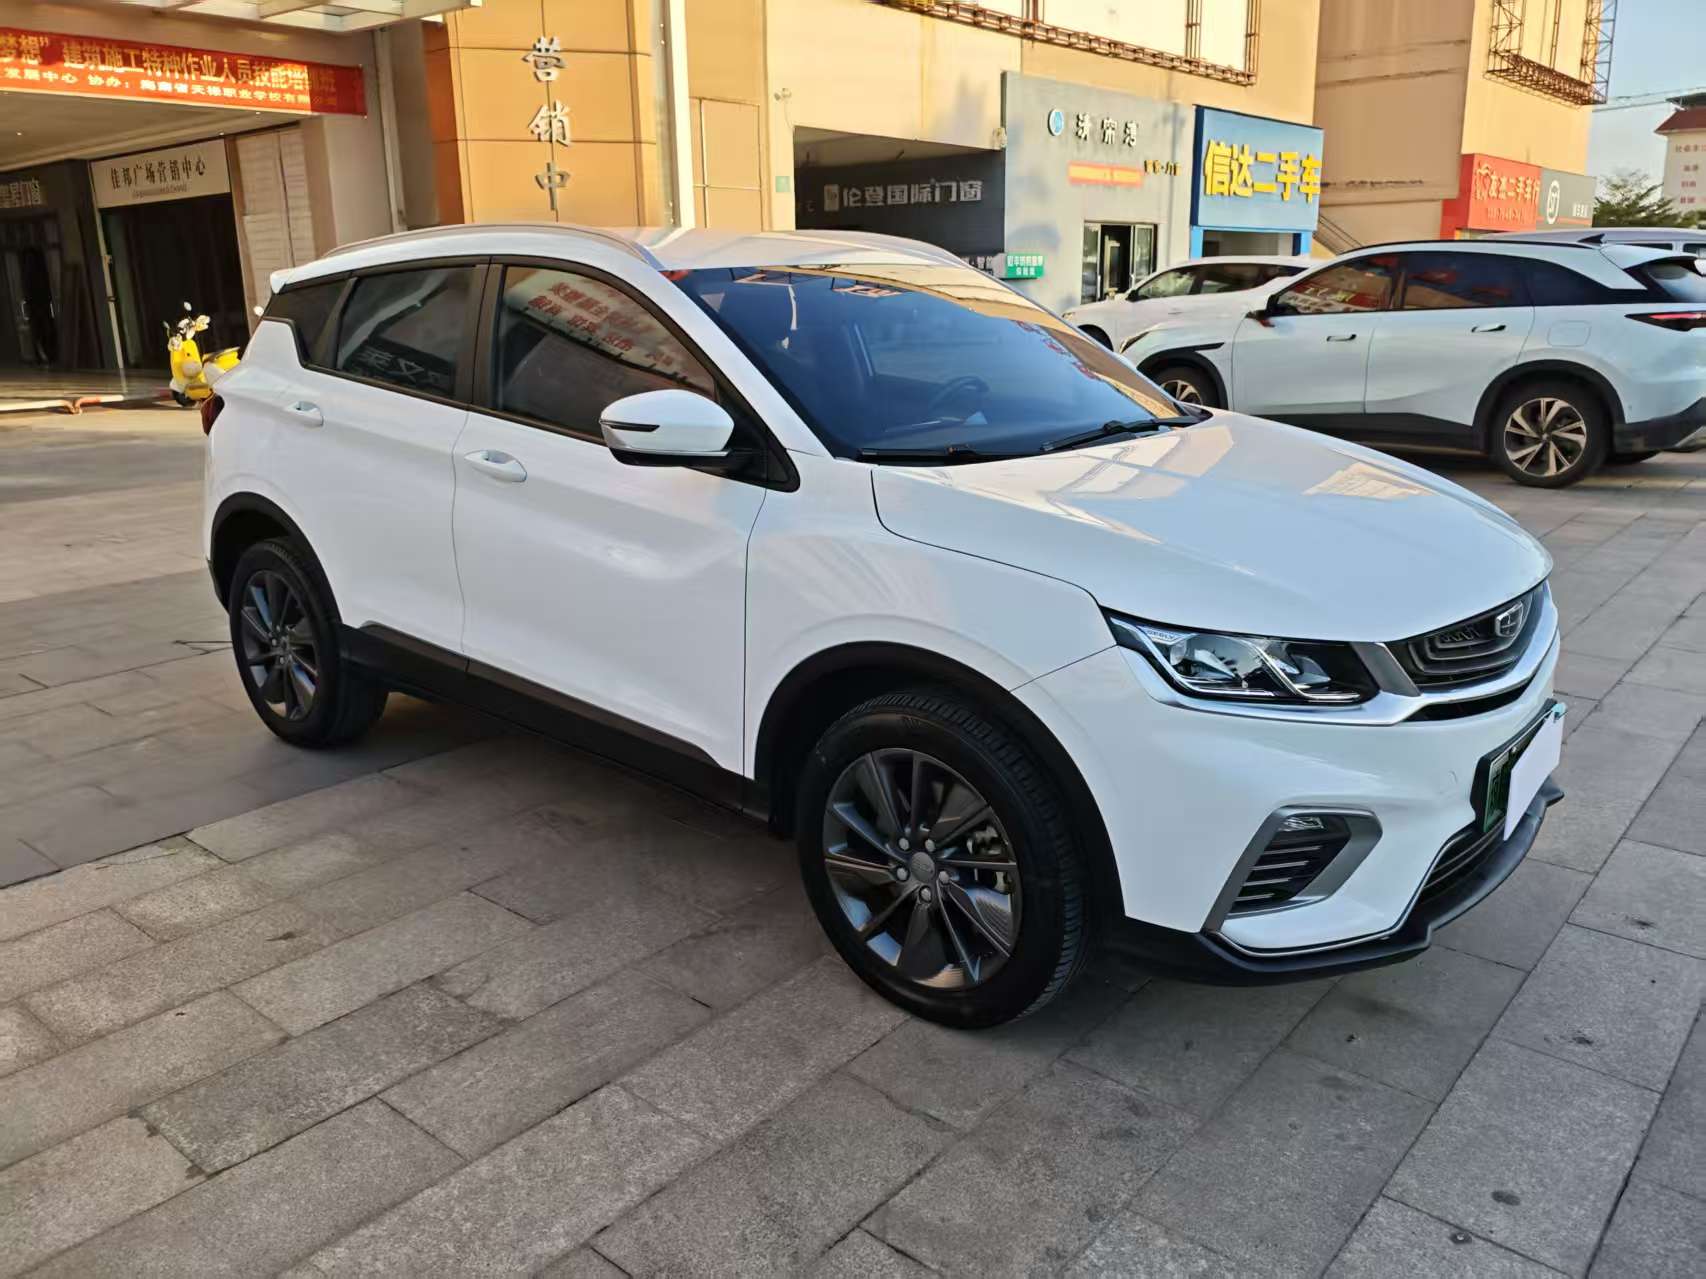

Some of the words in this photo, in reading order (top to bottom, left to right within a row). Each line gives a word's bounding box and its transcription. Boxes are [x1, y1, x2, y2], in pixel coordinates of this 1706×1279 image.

[521, 36, 571, 212] 营销中
[843, 180, 983, 208] 伦登国际门窗
[1203, 139, 1323, 204] 信达二手车
